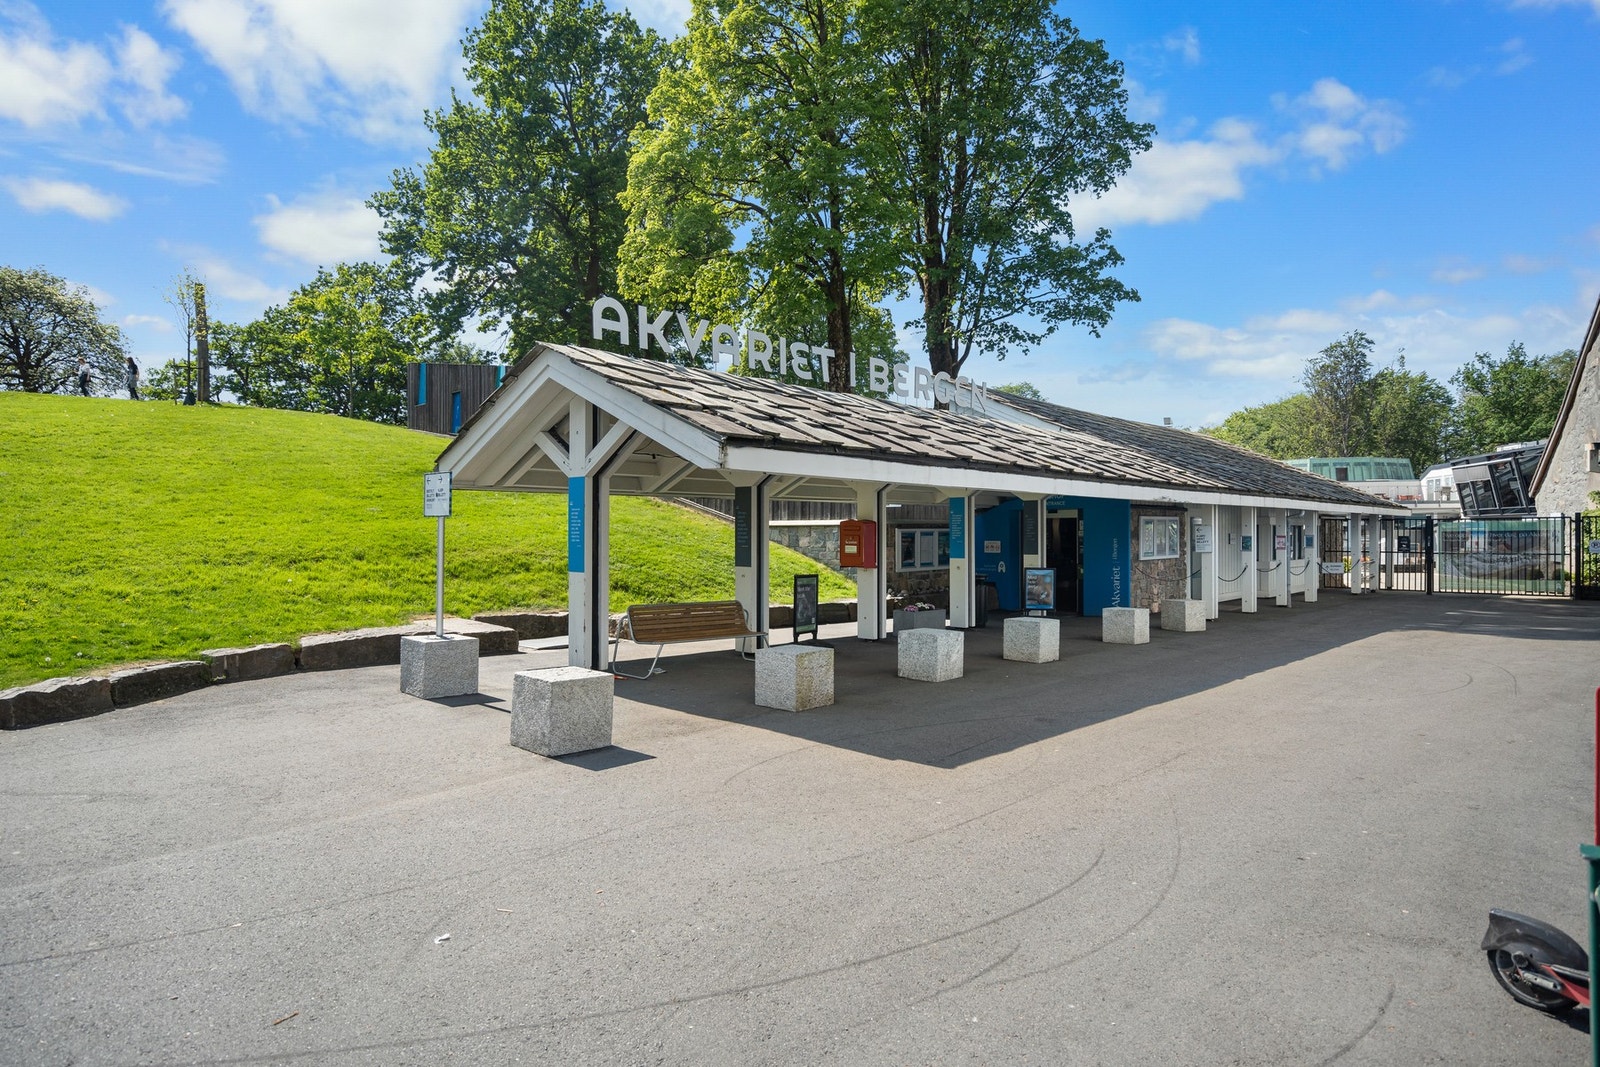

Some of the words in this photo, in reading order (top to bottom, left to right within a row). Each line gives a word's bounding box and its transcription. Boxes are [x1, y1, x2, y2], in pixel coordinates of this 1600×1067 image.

[592, 296, 835, 383] AKVARIET
[850, 351, 856, 388] I
[870, 357, 987, 412] BERGEN
[1111, 565, 1120, 607] Akvariet
